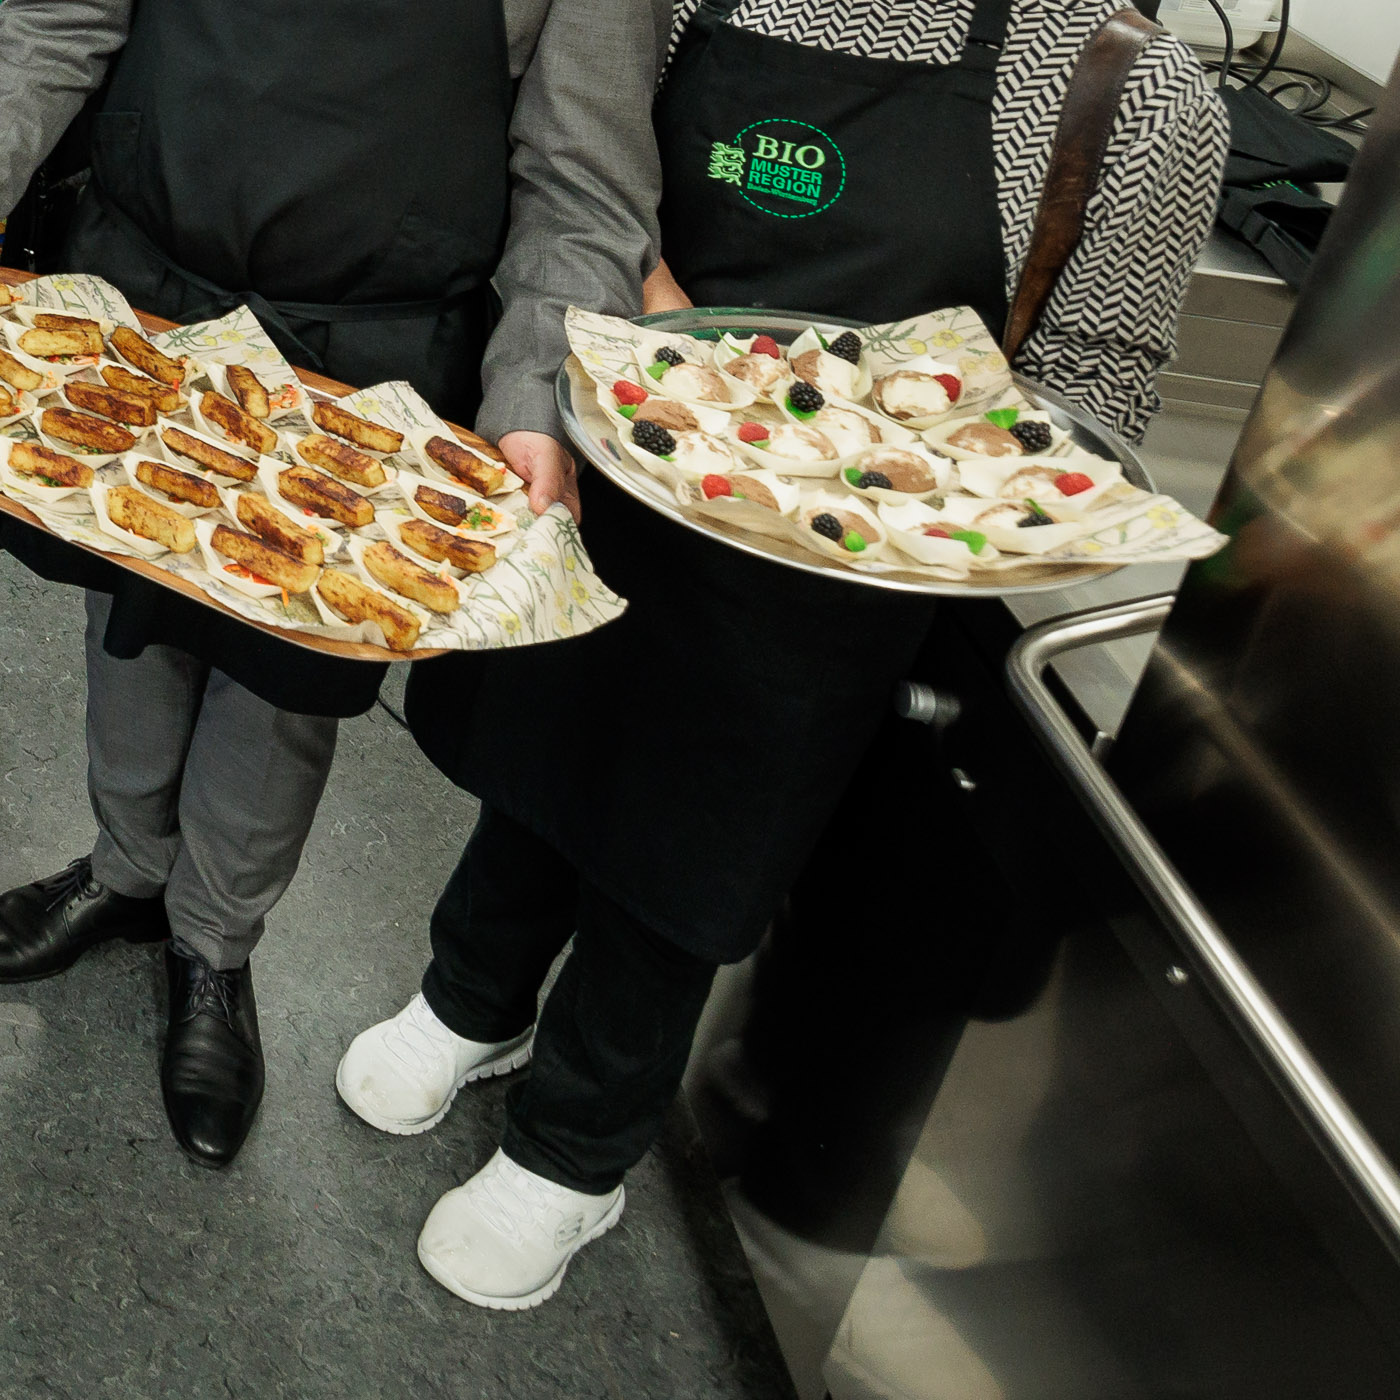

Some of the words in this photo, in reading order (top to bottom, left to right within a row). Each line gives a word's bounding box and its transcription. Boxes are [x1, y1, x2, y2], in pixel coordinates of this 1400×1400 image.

[752, 134, 825, 169] BIO
[750, 171, 820, 198] REGION
[752, 158, 822, 184] MUSTER
